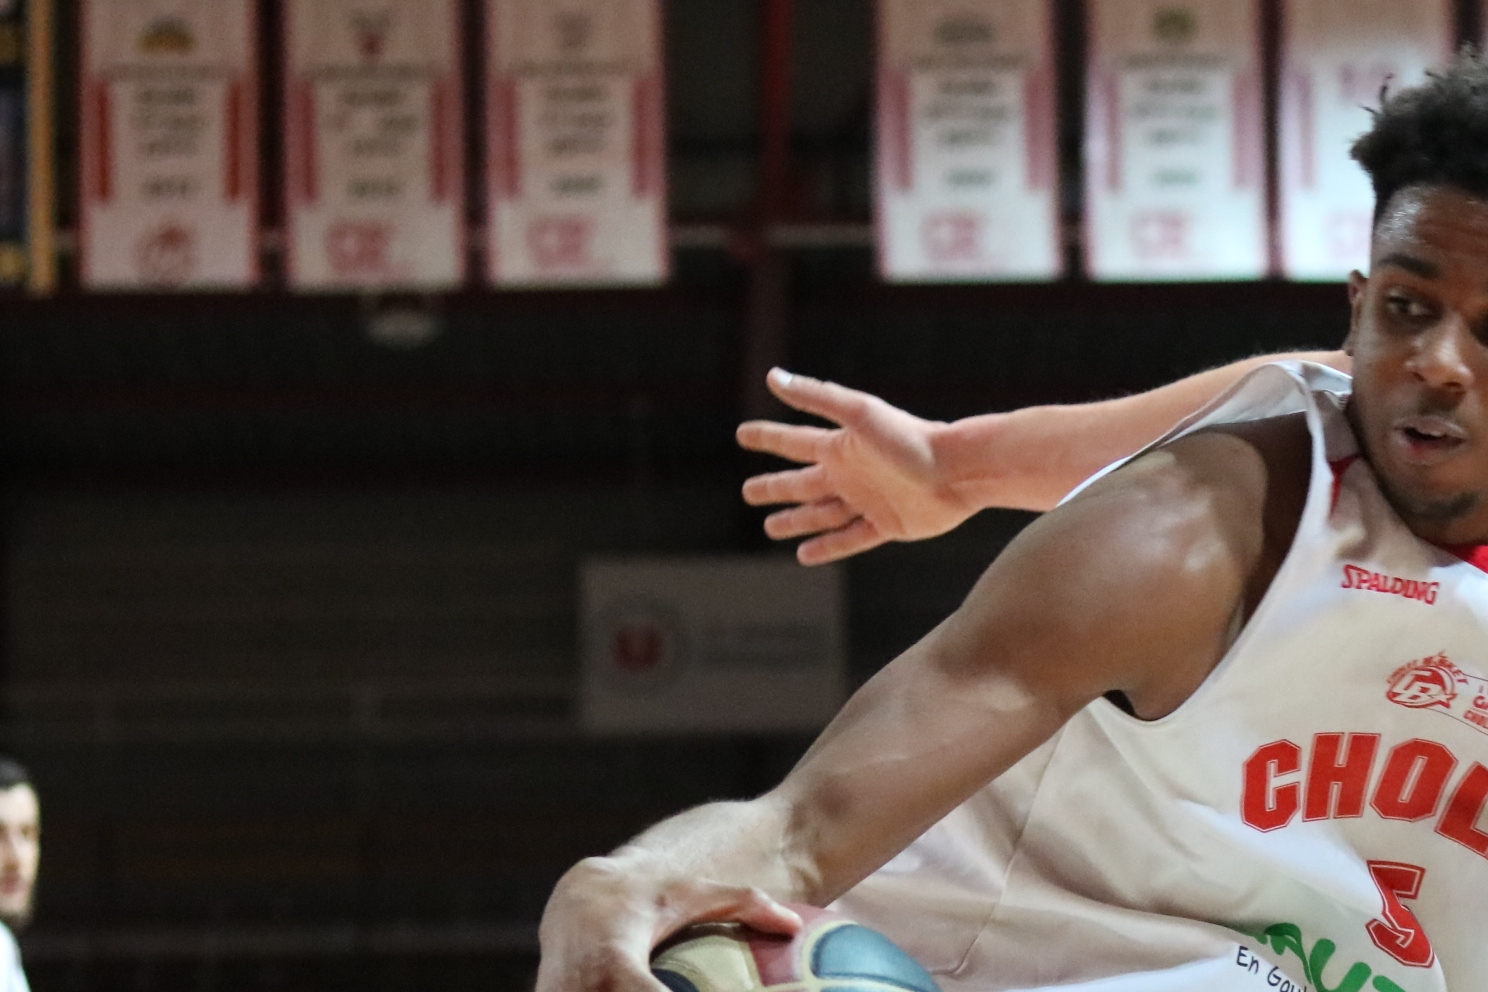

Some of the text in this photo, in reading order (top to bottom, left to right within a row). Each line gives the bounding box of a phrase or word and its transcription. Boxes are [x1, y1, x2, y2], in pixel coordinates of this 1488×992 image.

[1341, 564, 1440, 606] SPALDING
[1365, 859, 1434, 968] 5
[1236, 945, 1260, 975] En
